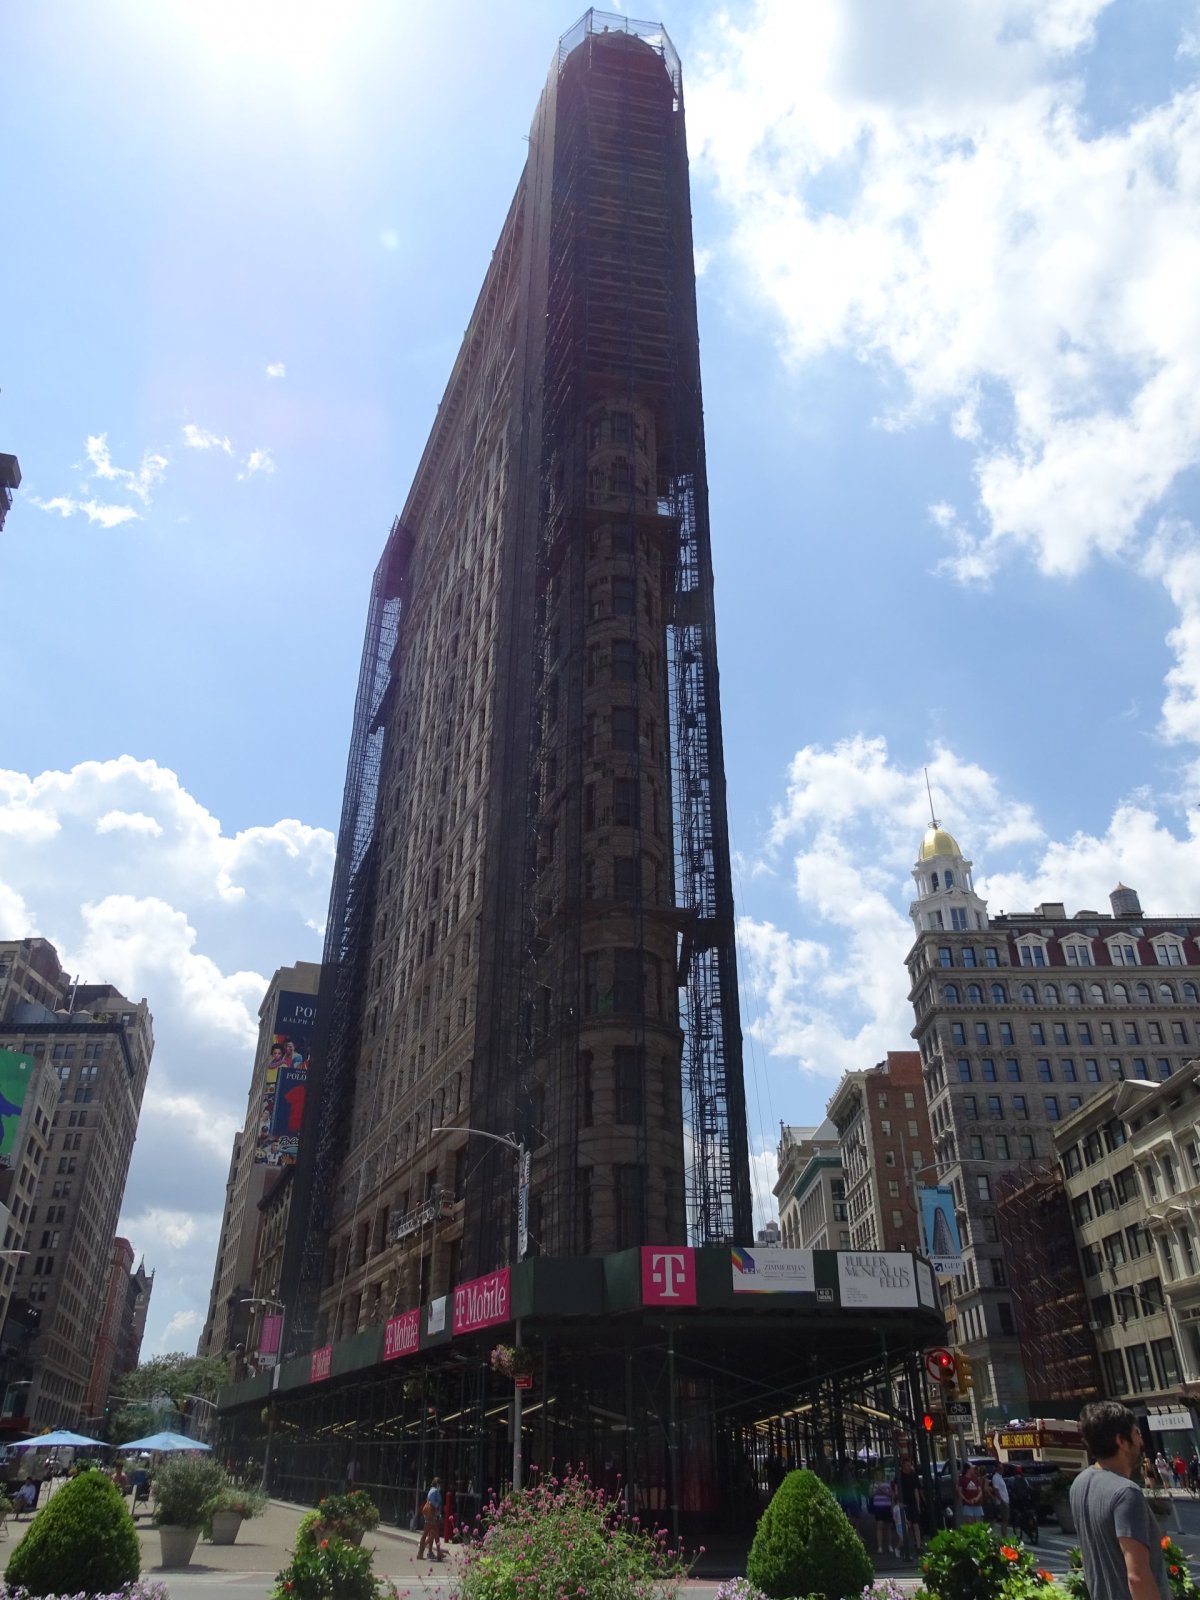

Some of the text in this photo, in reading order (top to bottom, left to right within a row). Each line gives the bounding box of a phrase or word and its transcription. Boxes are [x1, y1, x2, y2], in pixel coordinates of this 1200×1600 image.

[282, 1017, 307, 1025] RALPH
[286, 1072, 307, 1080] POLO
[285, 1085, 305, 1131] 1
[764, 1264, 807, 1273] ZIMMERMAN
[651, 1254, 686, 1297] T
